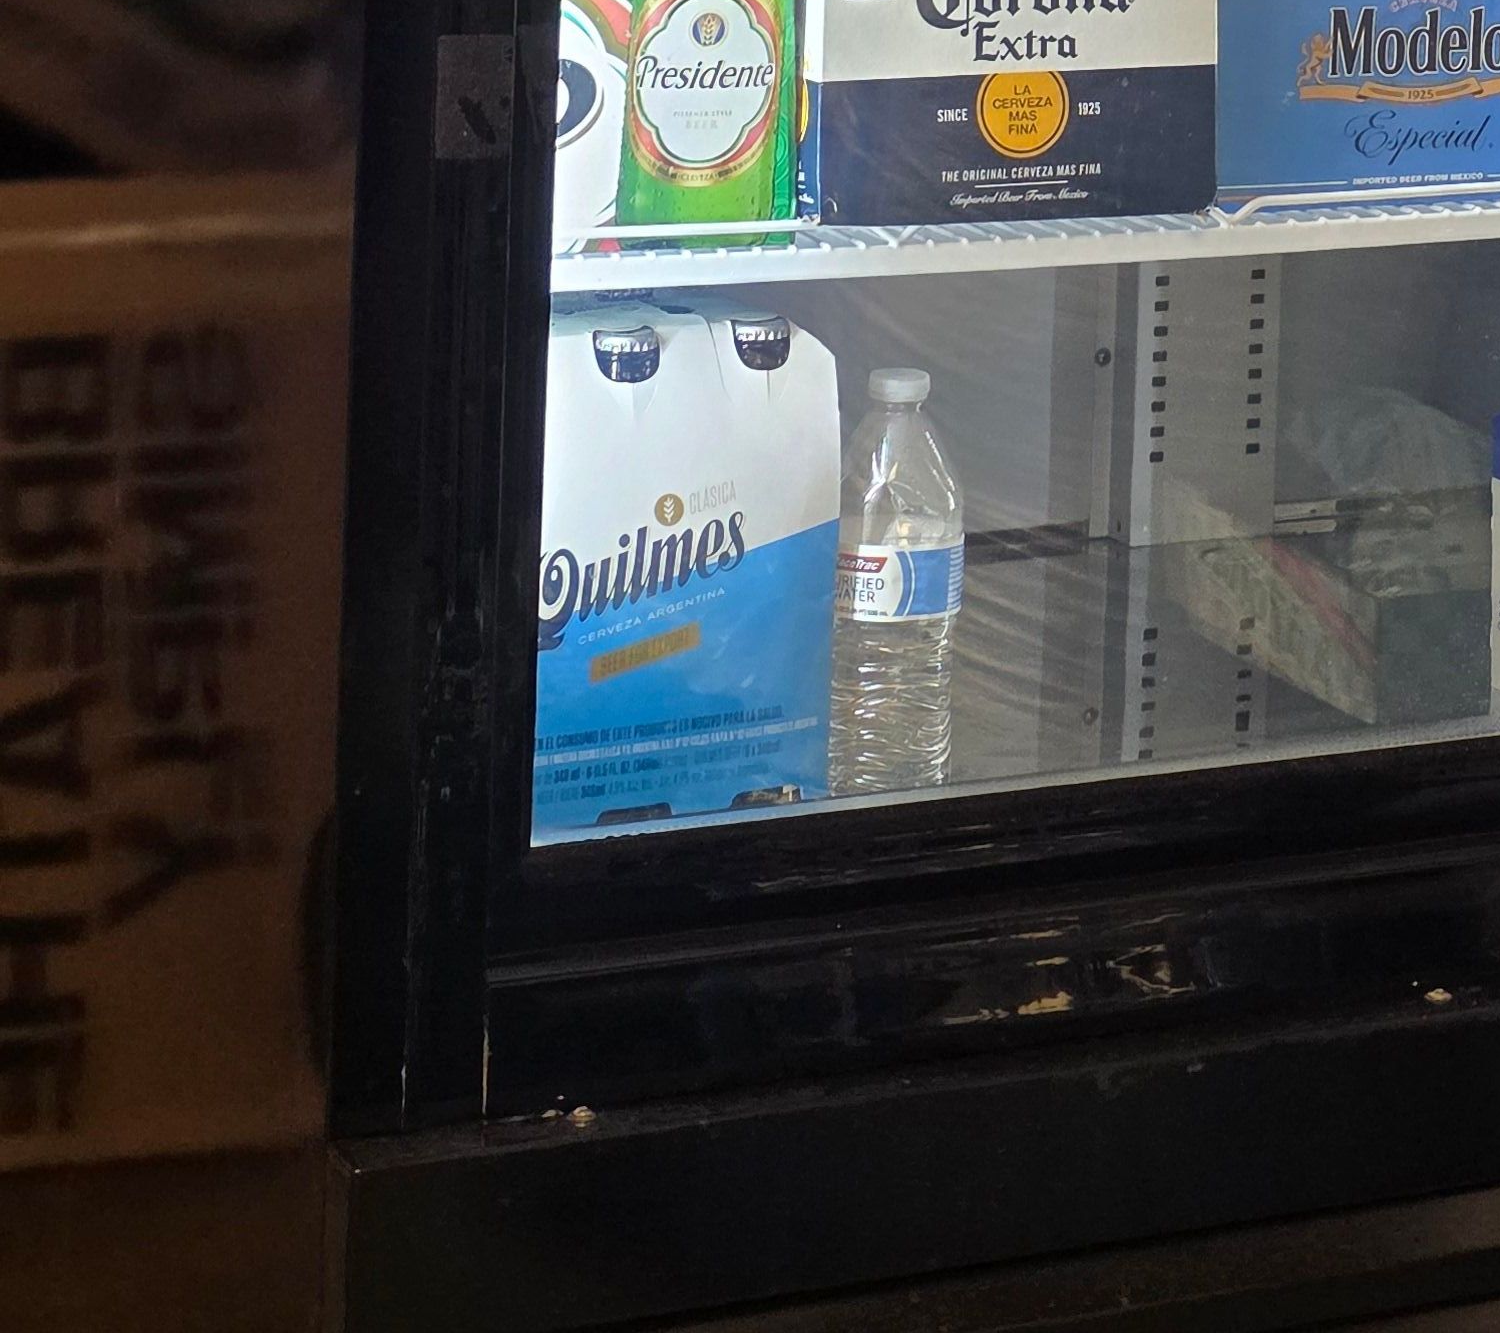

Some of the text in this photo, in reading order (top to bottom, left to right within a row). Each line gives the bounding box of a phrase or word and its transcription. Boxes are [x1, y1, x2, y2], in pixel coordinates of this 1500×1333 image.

[972, 20, 1079, 62] Extra
[636, 55, 774, 91] Presidente
[1013, 84, 1032, 97] LA
[1406, 89, 1435, 101] 1925
[991, 96, 1054, 110] CERVEZA
[1077, 100, 1101, 116] 1925
[936, 108, 969, 124] SINCE
[1007, 110, 1038, 123] MAS
[1007, 123, 1038, 136] FINA
[941, 163, 1102, 182] THE ORIGINAL CERVEZA MAS FINA
[1352, 173, 1484, 186] IMPORTED BEER FROM MEXICO
[537, 510, 745, 651] Quilmes
[577, 585, 727, 647] CERVEZA ARGENTINA
